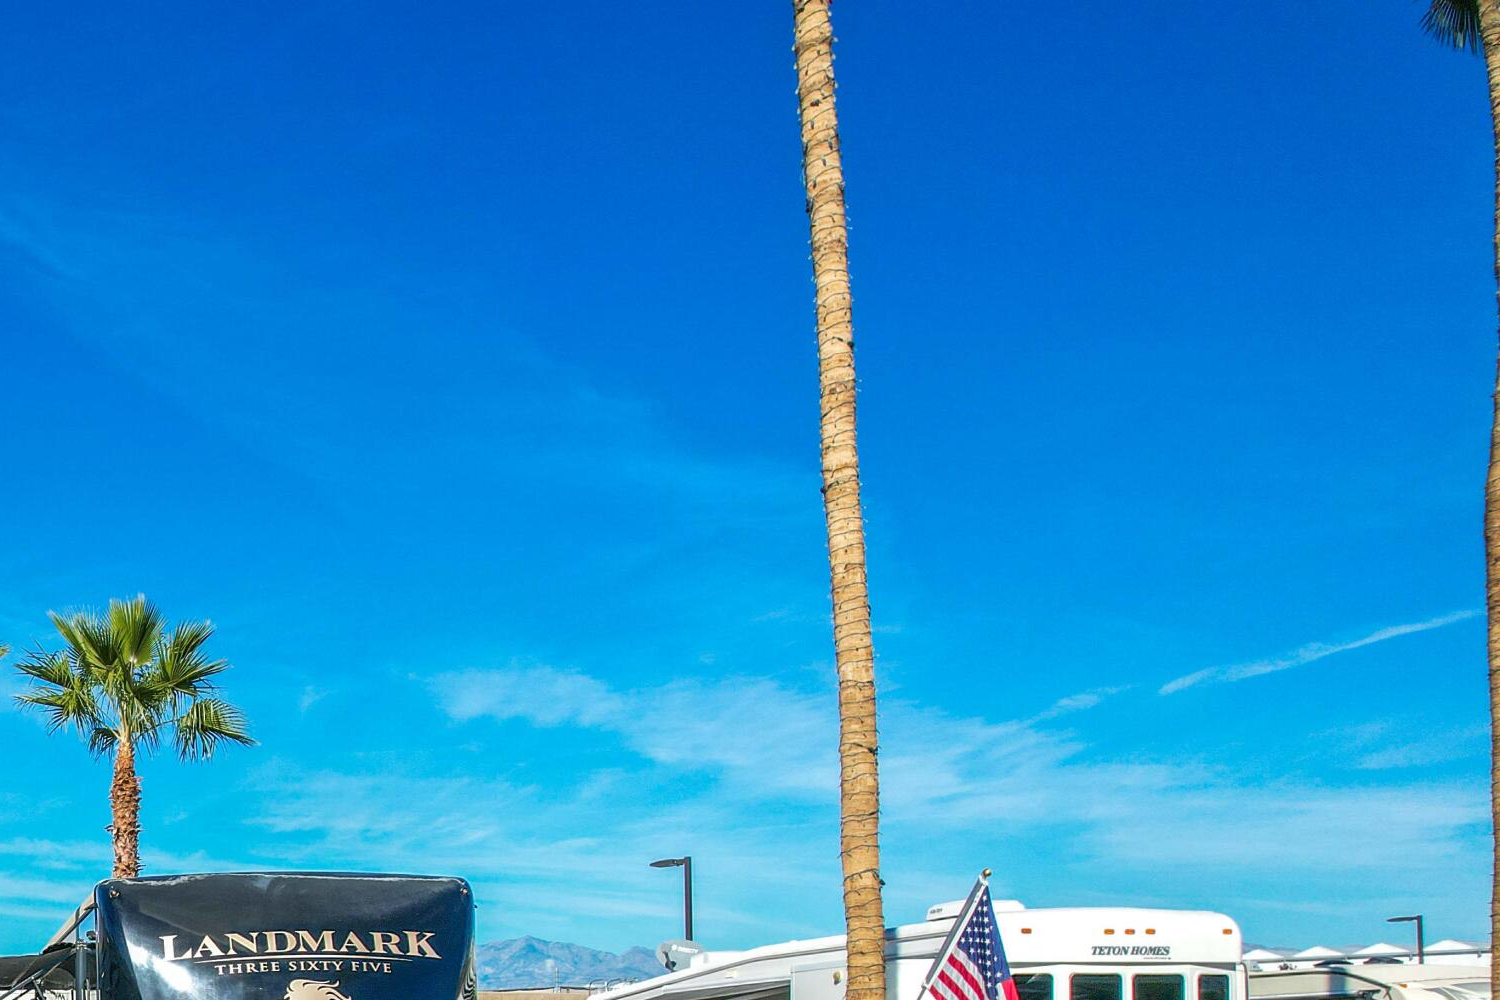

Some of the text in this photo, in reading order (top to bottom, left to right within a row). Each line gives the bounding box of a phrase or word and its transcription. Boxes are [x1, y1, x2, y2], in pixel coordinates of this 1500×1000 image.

[159, 930, 442, 962] LANDMARK
[1091, 945, 1171, 956] TETON HOMES
[214, 960, 392, 975] THREE SIXTY FIVE
